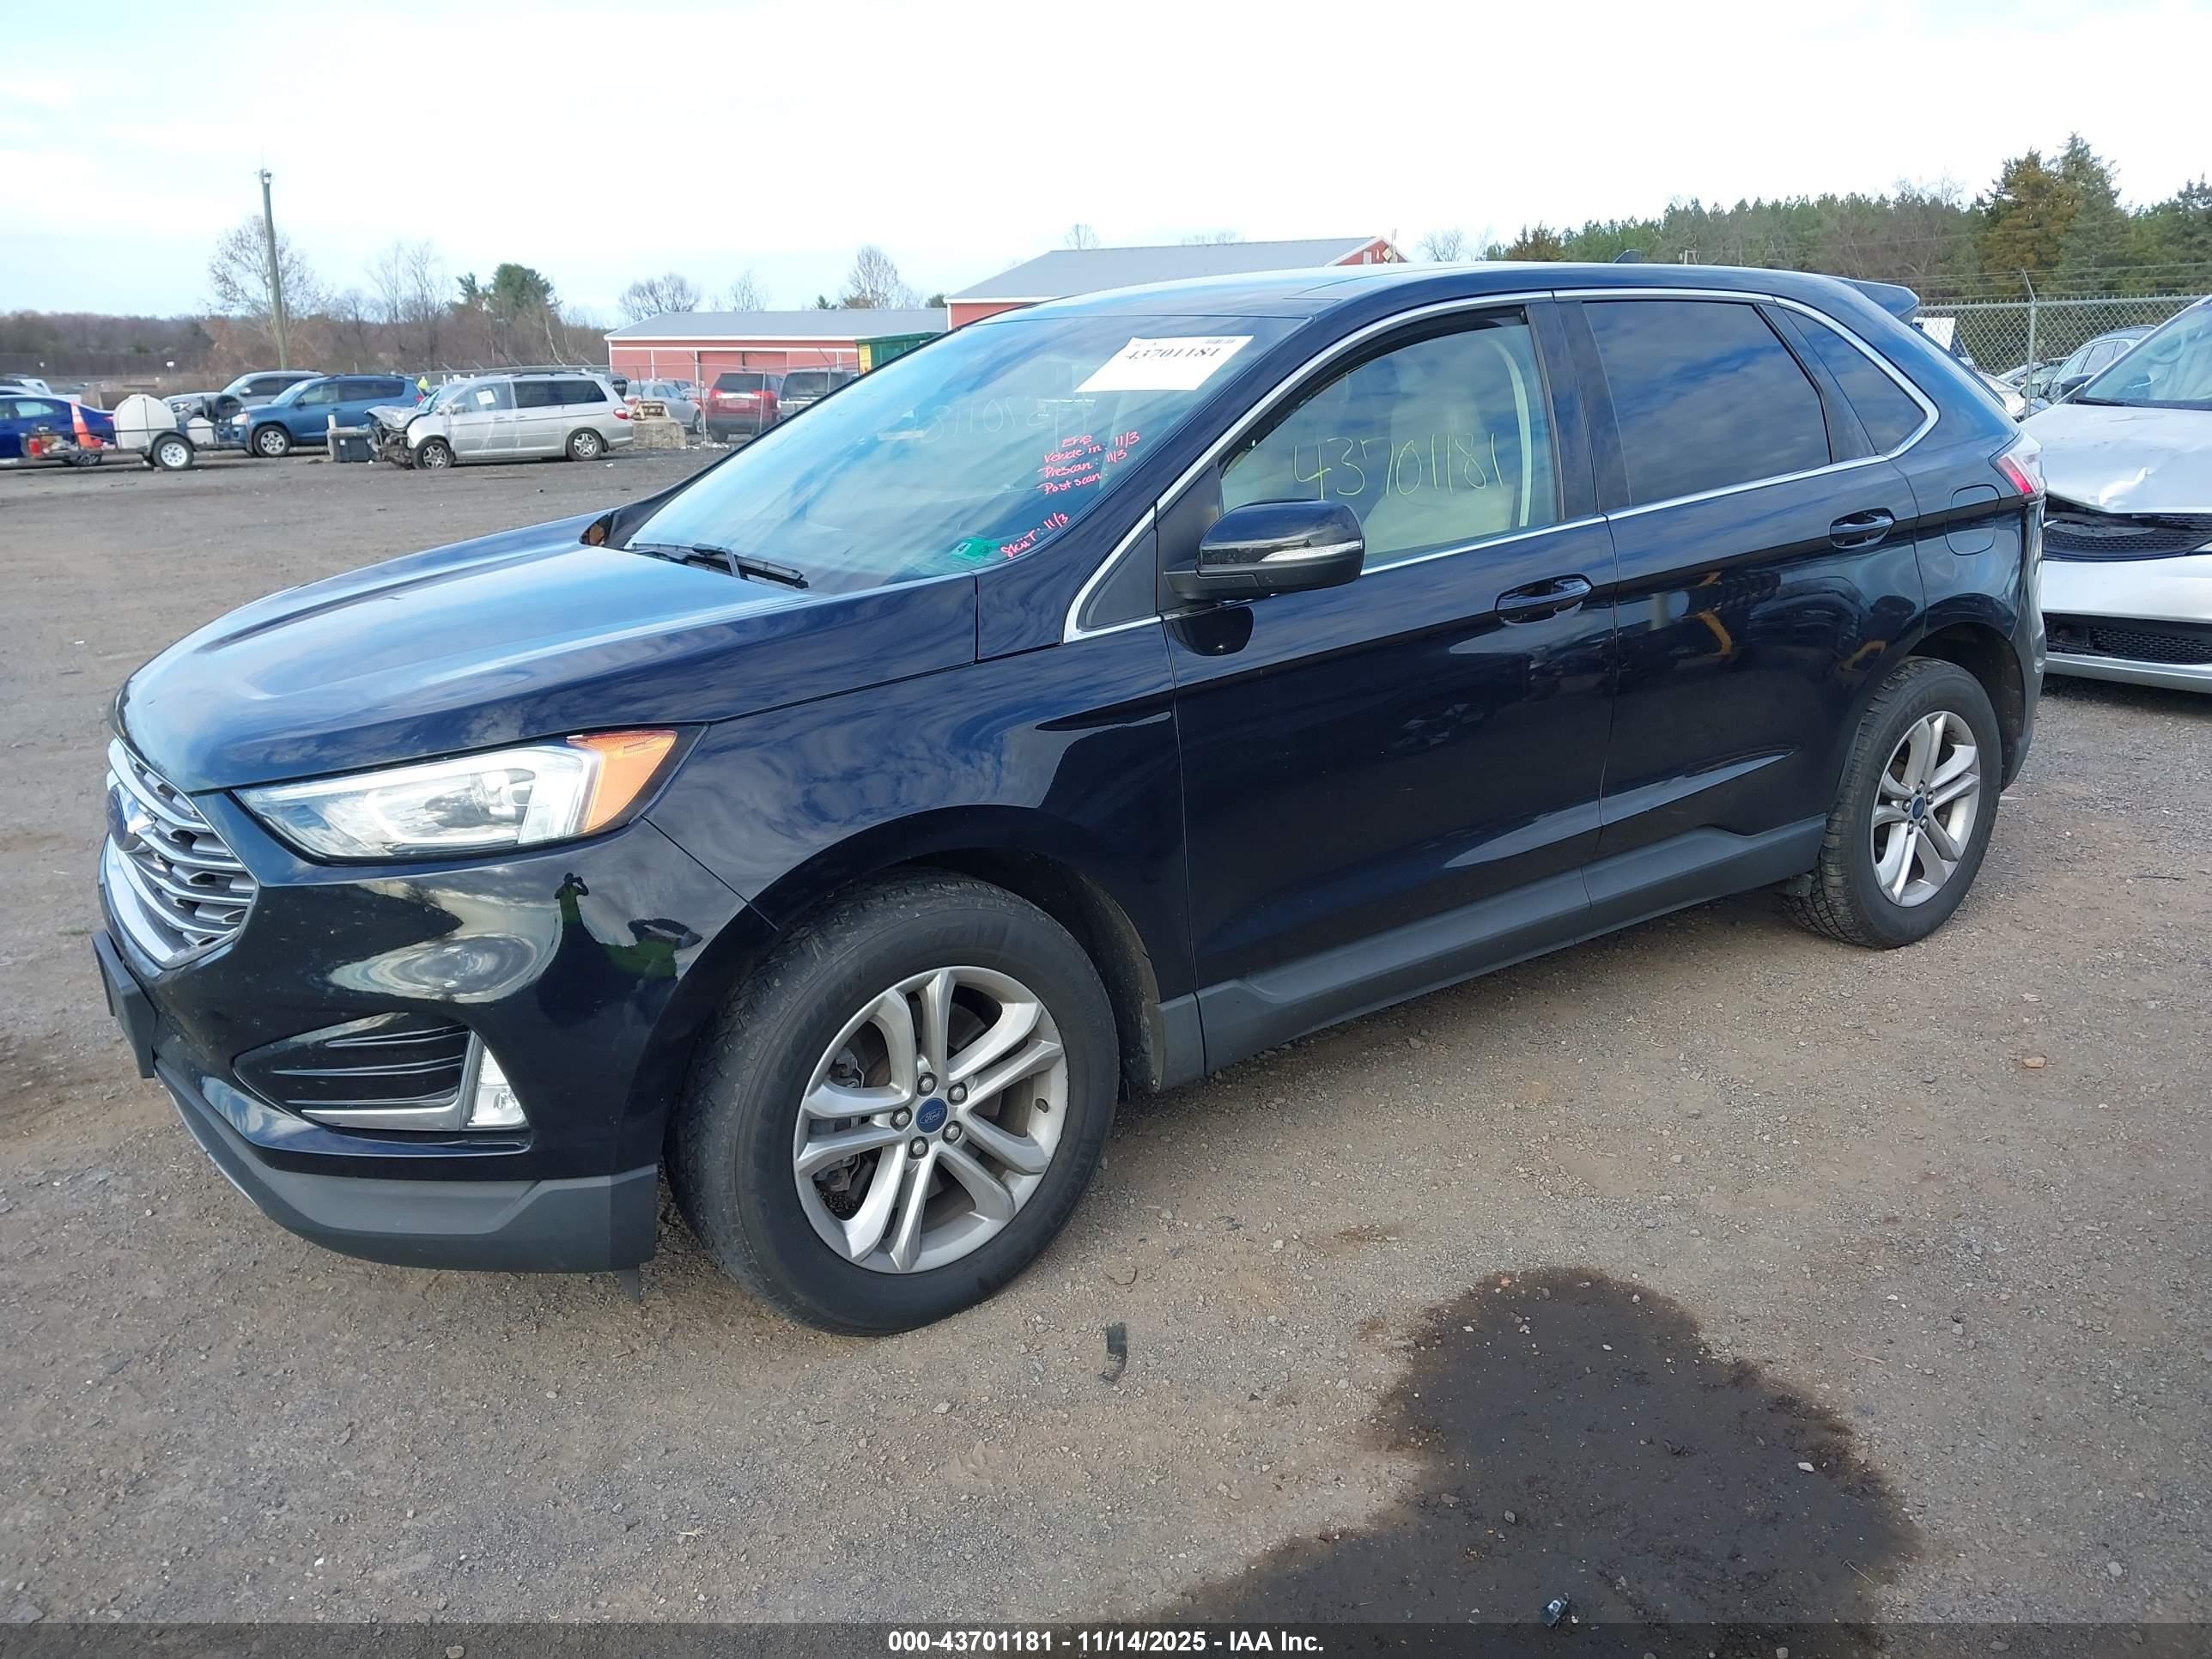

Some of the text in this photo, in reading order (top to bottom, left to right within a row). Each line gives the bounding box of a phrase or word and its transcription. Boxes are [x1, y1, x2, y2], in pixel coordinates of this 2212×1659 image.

[1125, 346, 1223, 360] 43701181
[1115, 431, 1140, 448] 11/3
[1106, 449, 1127, 463] 11/3
[1294, 432, 1504, 500] 43701181
[1043, 513, 1068, 529] 11/3
